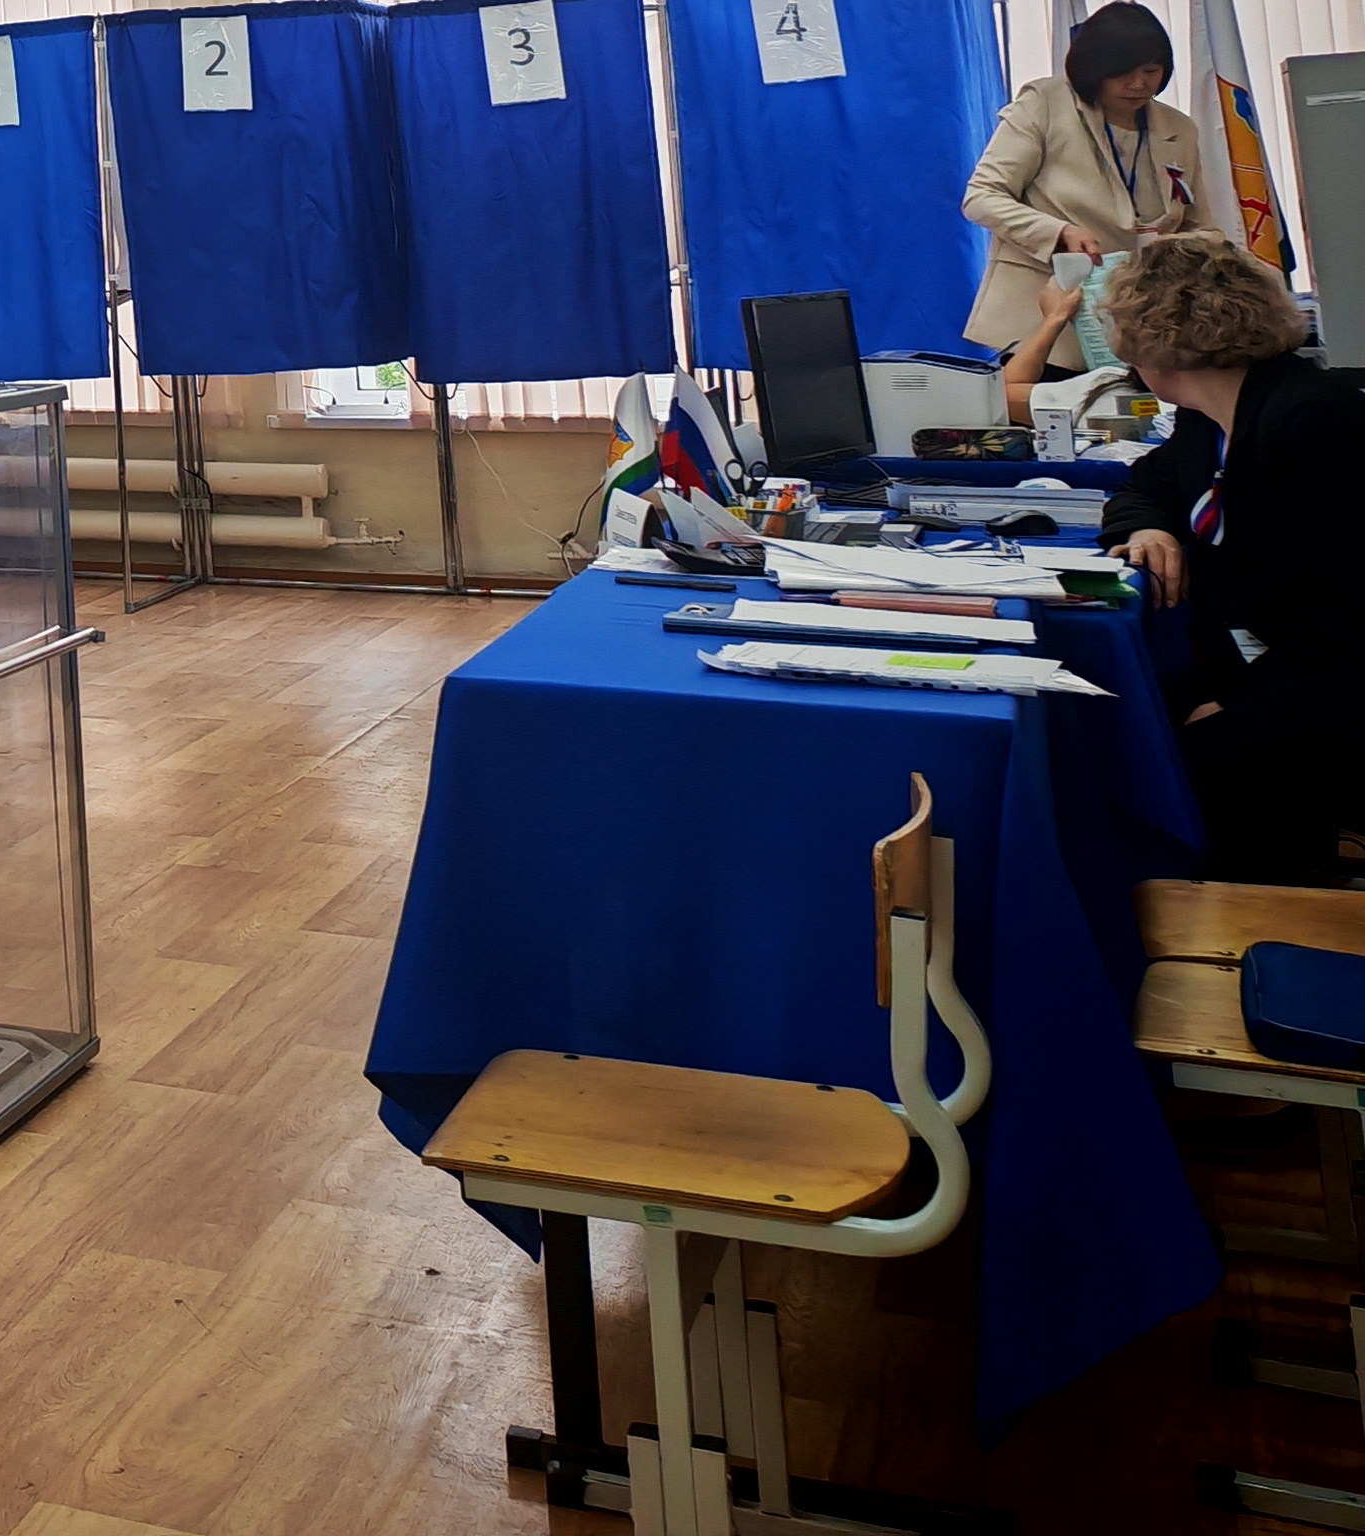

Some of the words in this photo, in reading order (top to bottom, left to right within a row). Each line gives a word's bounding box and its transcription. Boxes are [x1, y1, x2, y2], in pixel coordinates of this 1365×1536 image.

[776, 2, 808, 42] 4
[204, 40, 229, 76] 2
[508, 28, 535, 66] 3
